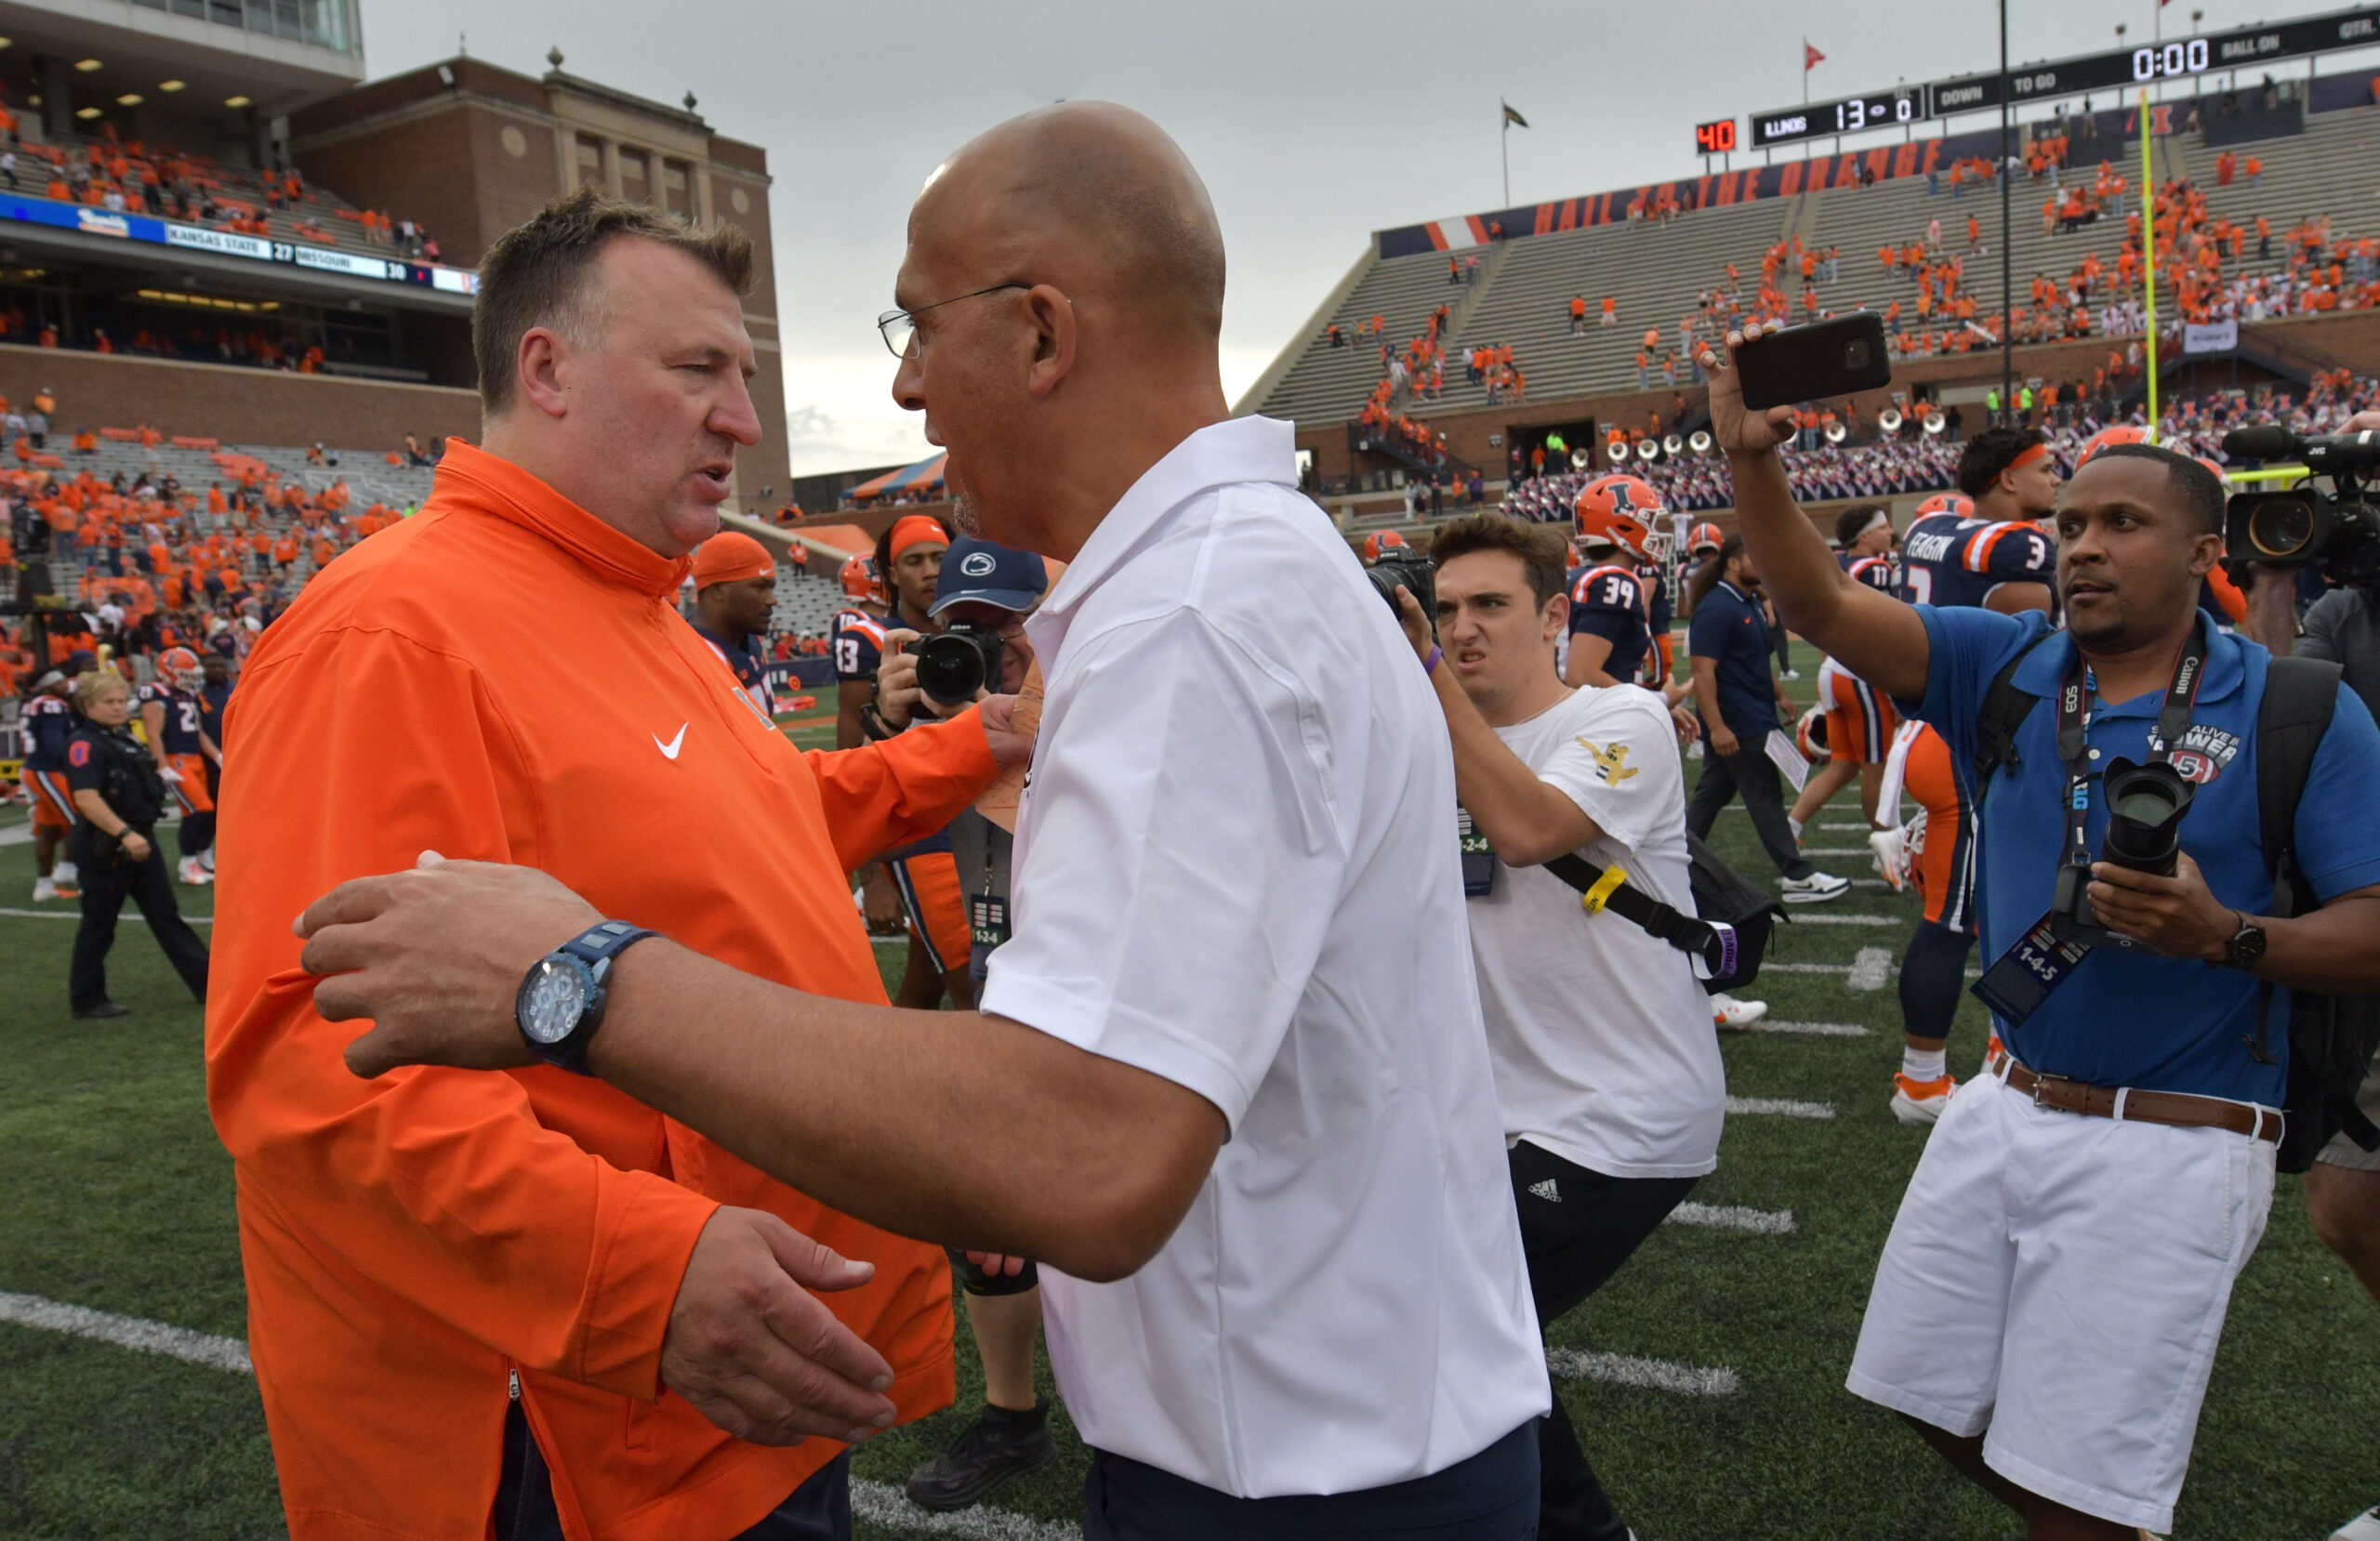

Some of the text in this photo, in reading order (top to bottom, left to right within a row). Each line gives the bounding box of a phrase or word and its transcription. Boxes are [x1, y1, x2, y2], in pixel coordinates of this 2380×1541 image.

[2134, 38, 2208, 81] 0:00
[2221, 34, 2280, 59] BALL ON
[1941, 86, 1983, 106] DOWN
[2015, 72, 2056, 93] TO GO
[1765, 116, 1807, 138] ILLINOIS
[1836, 99, 1865, 129] 13
[1697, 120, 1736, 151] 40
[1534, 192, 1613, 235] HAIL
[1697, 168, 1762, 210] THE
[1779, 138, 1944, 195] ORANGE
[170, 229, 294, 261] KANSAS STATE 27
[298, 251, 350, 269] MISSOURI
[2308, 447, 2326, 455] JVC
[1907, 532, 1955, 562] FEAGIN
[2025, 534, 2046, 571] 3
[1872, 565, 1888, 586] 11
[1603, 575, 1634, 610] 39
[835, 638, 860, 674] 13
[2175, 656, 2199, 694] Canon
[2066, 685, 2078, 713] EOS
[2190, 725, 2230, 743] ALIVE
[2178, 756, 2200, 777] 5
[975, 930, 998, 944] 1-2-4
